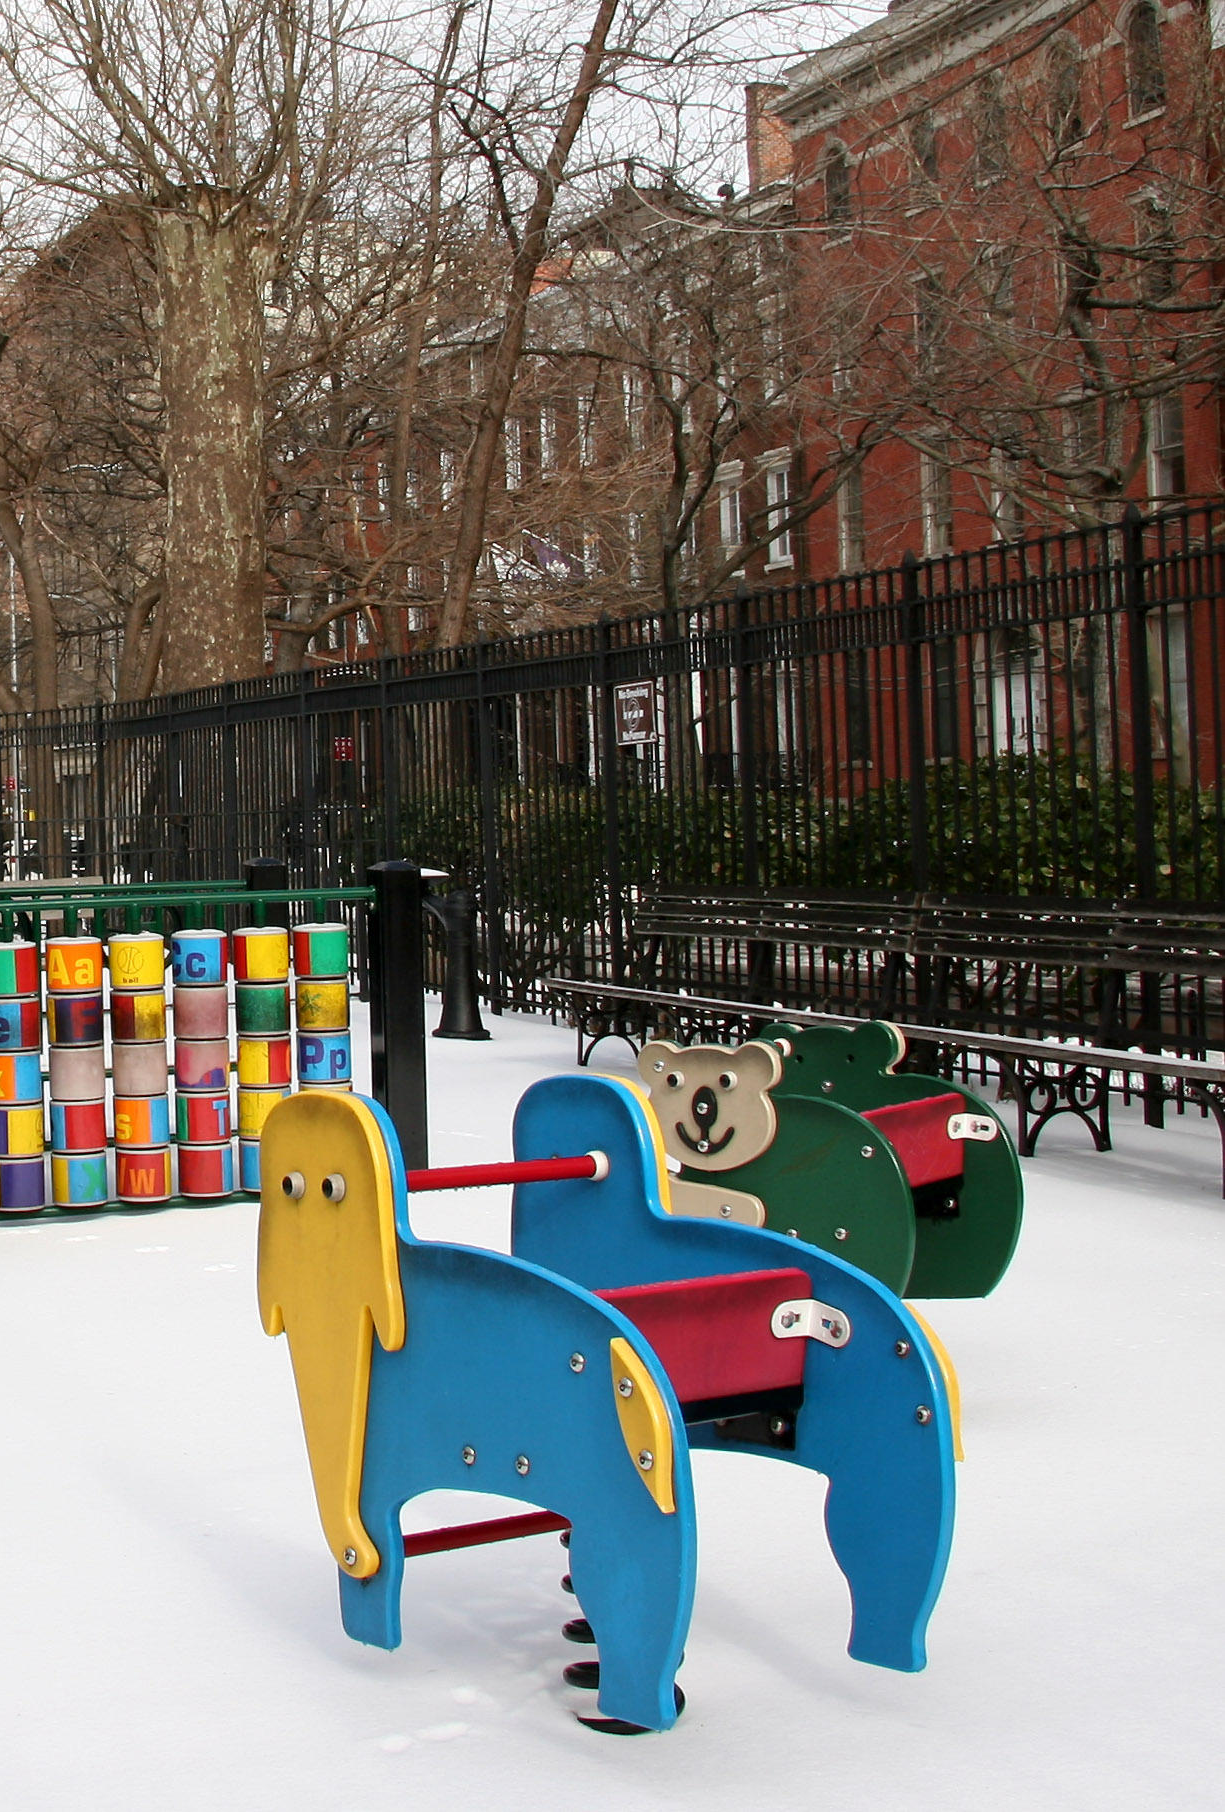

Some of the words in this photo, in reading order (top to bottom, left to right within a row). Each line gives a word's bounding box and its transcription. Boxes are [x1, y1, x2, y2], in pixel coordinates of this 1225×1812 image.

[47, 948, 95, 986] Aa
[122, 976, 139, 984] ball
[69, 1000, 97, 1040] F
[300, 1037, 347, 1079] Pp
[211, 1099, 228, 1137] T
